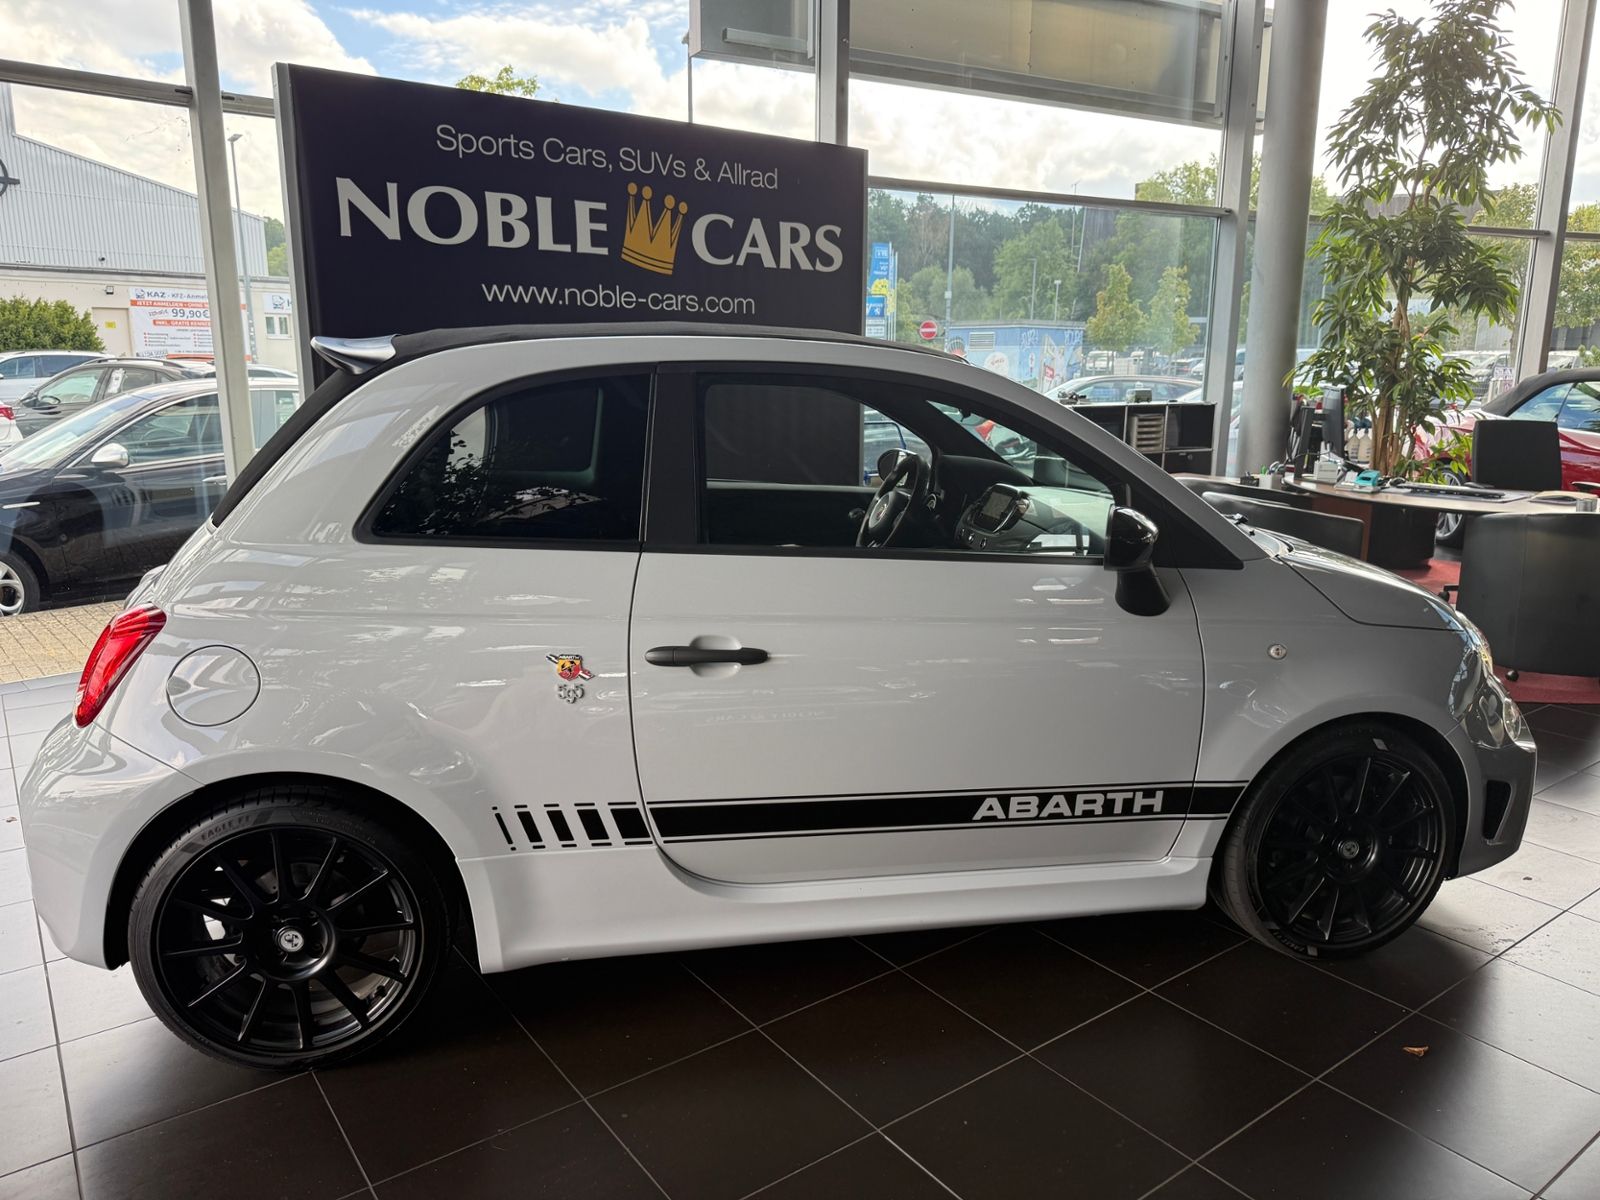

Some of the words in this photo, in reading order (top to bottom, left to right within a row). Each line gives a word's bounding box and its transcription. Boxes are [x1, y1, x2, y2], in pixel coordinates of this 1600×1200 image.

[436, 124, 535, 160] Sports
[542, 137, 613, 173] Cars,
[619, 147, 687, 178] SUVs
[694, 157, 712, 182] &
[717, 161, 778, 189] Allrad
[336, 177, 609, 255] NOBLE
[691, 213, 844, 273] CARS
[146, 291, 166, 299] KAZ
[481, 283, 755, 315] www.noble-cars.com
[972, 790, 1164, 821] ABARTH
